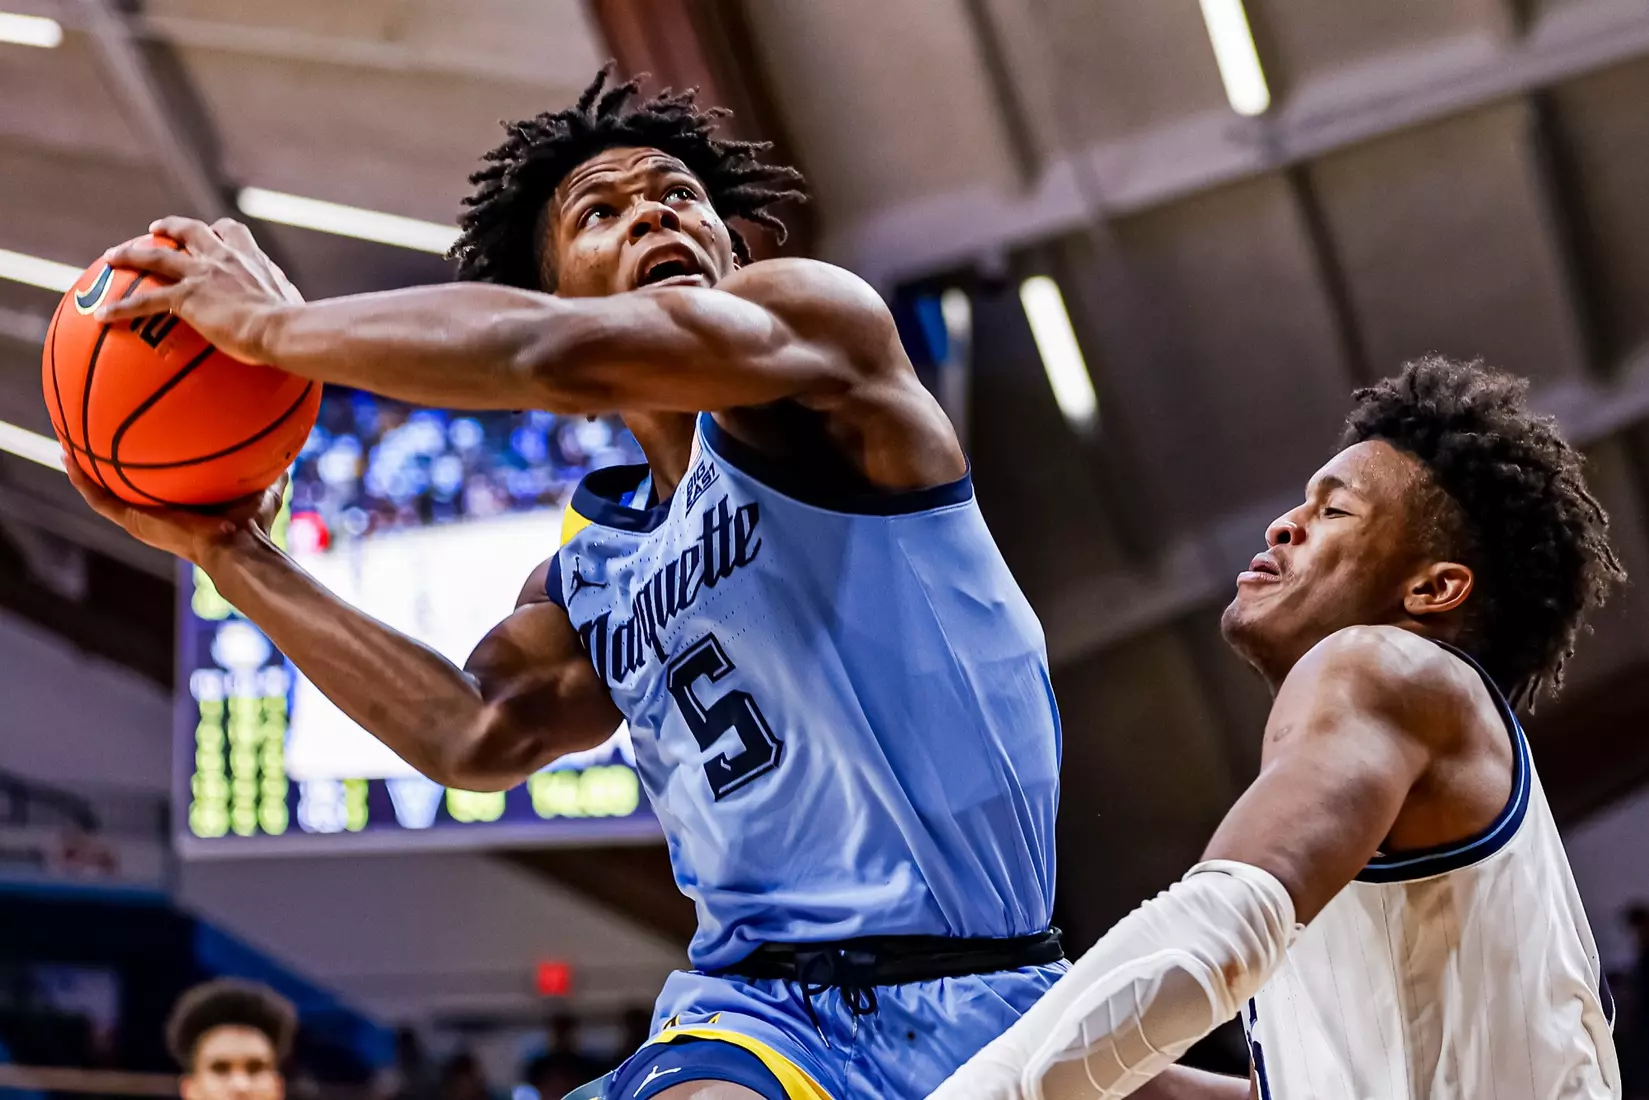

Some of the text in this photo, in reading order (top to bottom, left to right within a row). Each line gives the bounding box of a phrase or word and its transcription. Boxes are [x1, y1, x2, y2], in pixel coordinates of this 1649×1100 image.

[686, 459, 706, 495] BIG
[686, 461, 717, 510] EAST
[667, 632, 784, 801] 5
